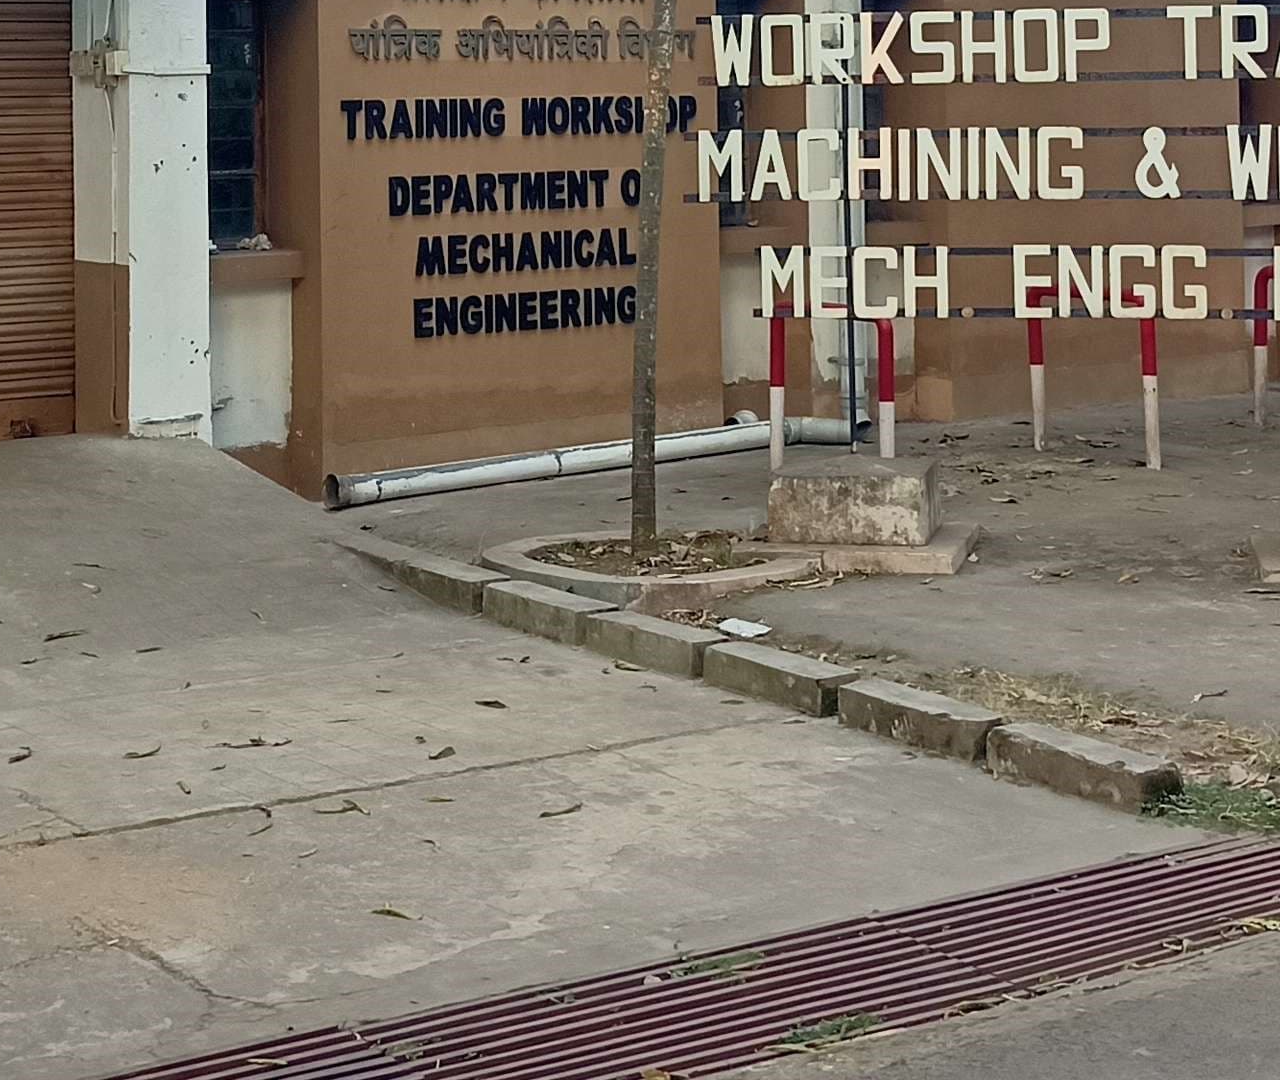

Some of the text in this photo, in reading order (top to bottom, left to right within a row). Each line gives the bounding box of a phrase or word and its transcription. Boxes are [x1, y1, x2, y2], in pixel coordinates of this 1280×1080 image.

[348, 15, 696, 61] यांत्रिक अभियांत्रिकी विग
[711, 8, 1111, 86] WORKSHOP
[341, 98, 506, 141] TRAINING
[698, 127, 1084, 202] MACHINING
[1134, 126, 1182, 199] &
[388, 169, 641, 217] DEPARTMENT O
[415, 227, 637, 277] MECHANICAL
[413, 286, 637, 339] ENGINEERING
